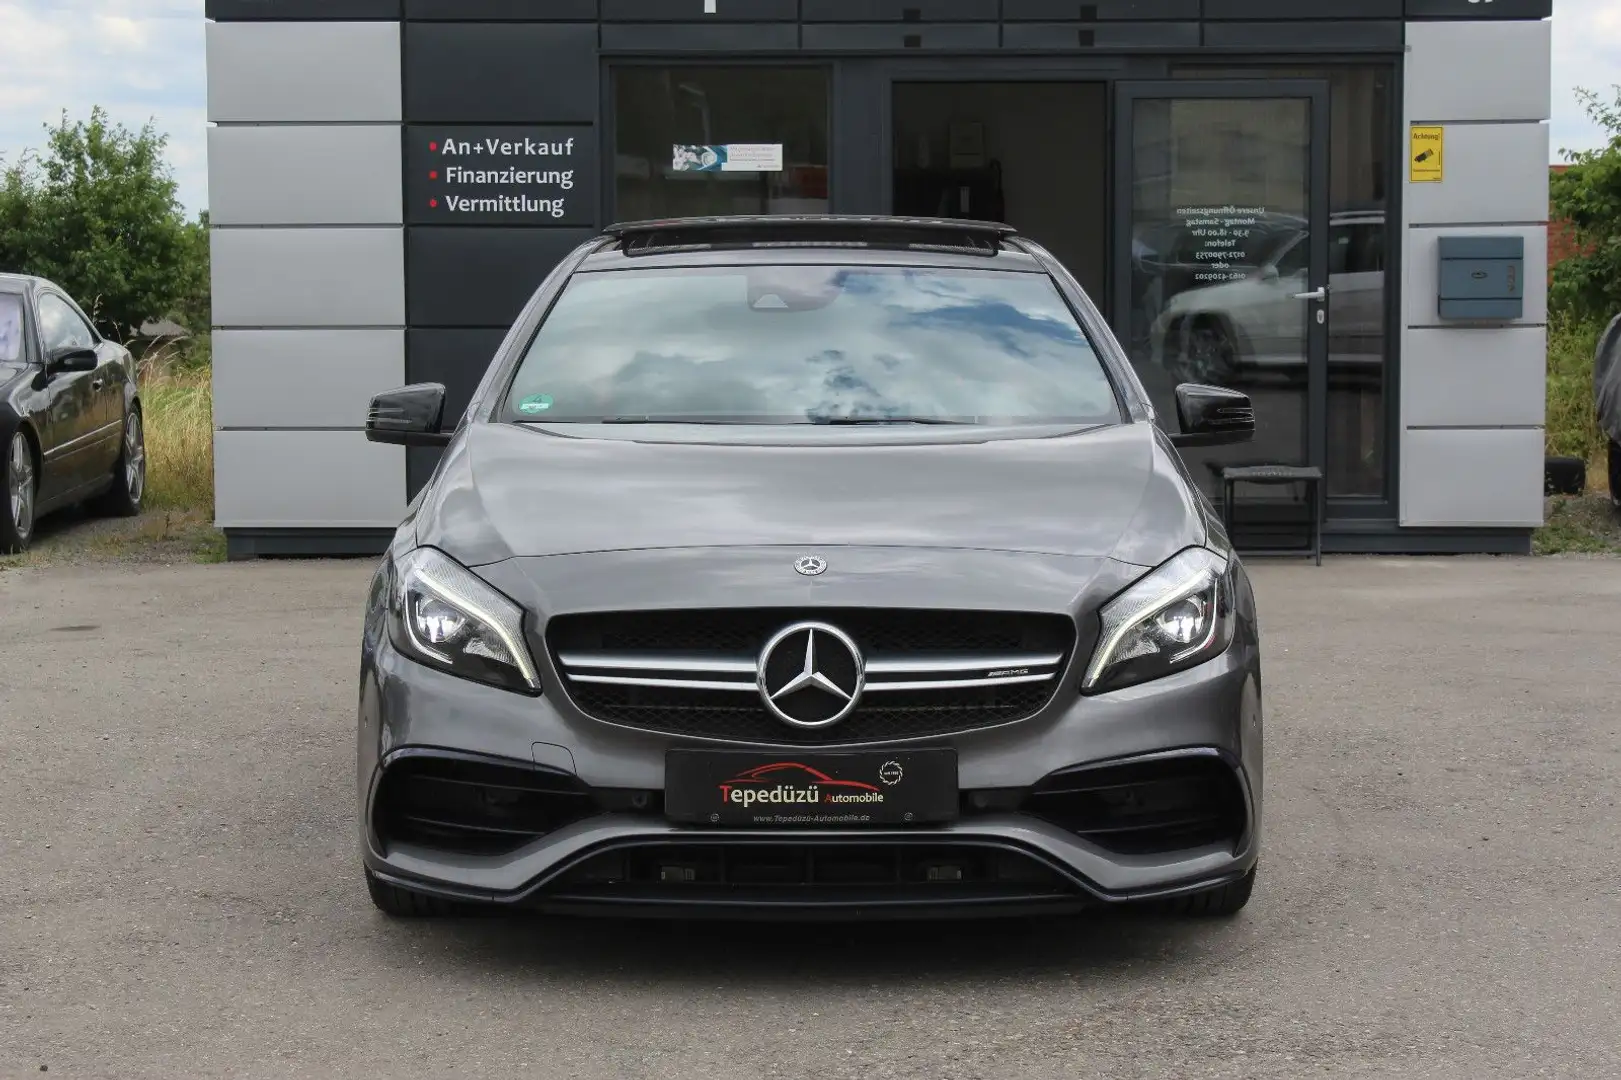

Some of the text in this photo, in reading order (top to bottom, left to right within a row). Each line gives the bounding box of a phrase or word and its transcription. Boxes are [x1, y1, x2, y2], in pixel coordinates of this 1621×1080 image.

[442, 137, 574, 156] An+Verkauf
[446, 166, 574, 190] Finanzierung
[445, 194, 565, 218] Vermittlung
[720, 784, 884, 807] Tepedüzü Automobile
